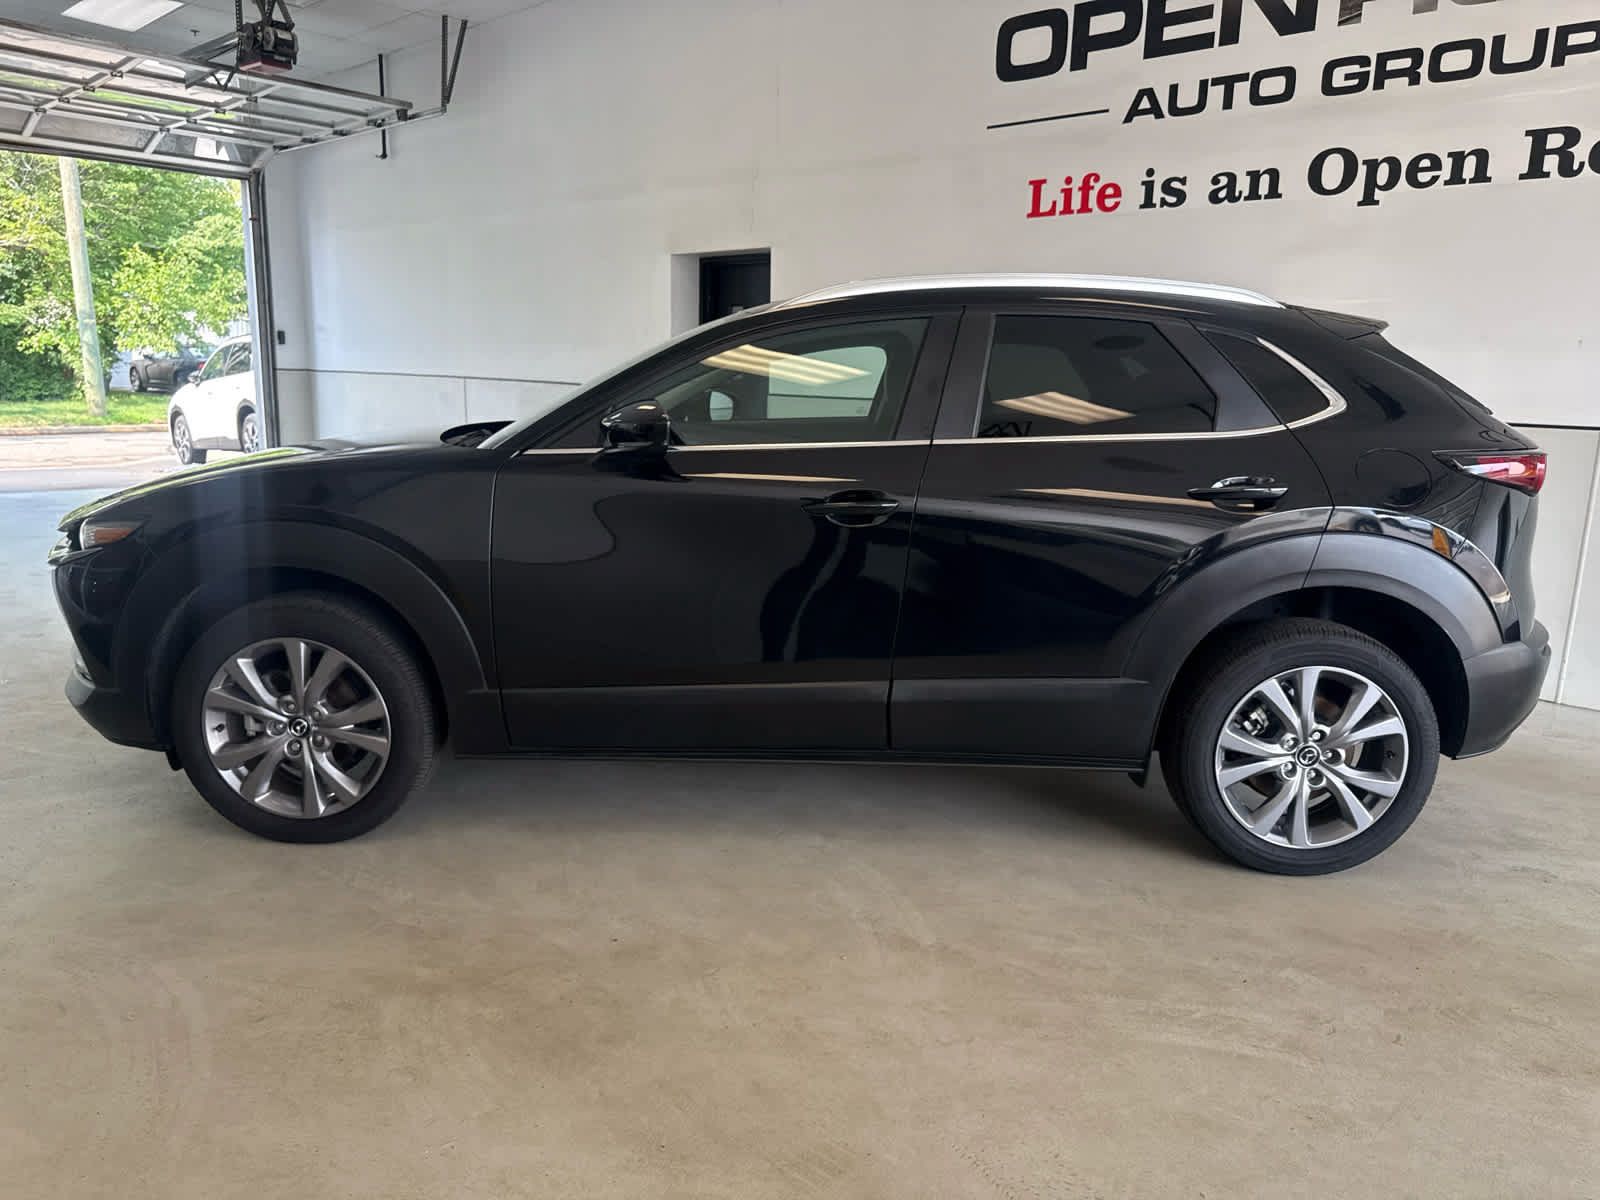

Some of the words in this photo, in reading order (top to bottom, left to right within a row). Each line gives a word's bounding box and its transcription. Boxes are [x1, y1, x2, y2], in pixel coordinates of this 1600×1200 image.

[995, 0, 1319, 83] OPEN
[1122, 65, 1297, 125] AUTO
[1320, 19, 1600, 97] GROUP
[1026, 172, 1123, 219] Life
[1138, 167, 1188, 210] is
[1207, 167, 1283, 206] an
[1307, 145, 1492, 207] Open
[1518, 125, 1600, 181] R
